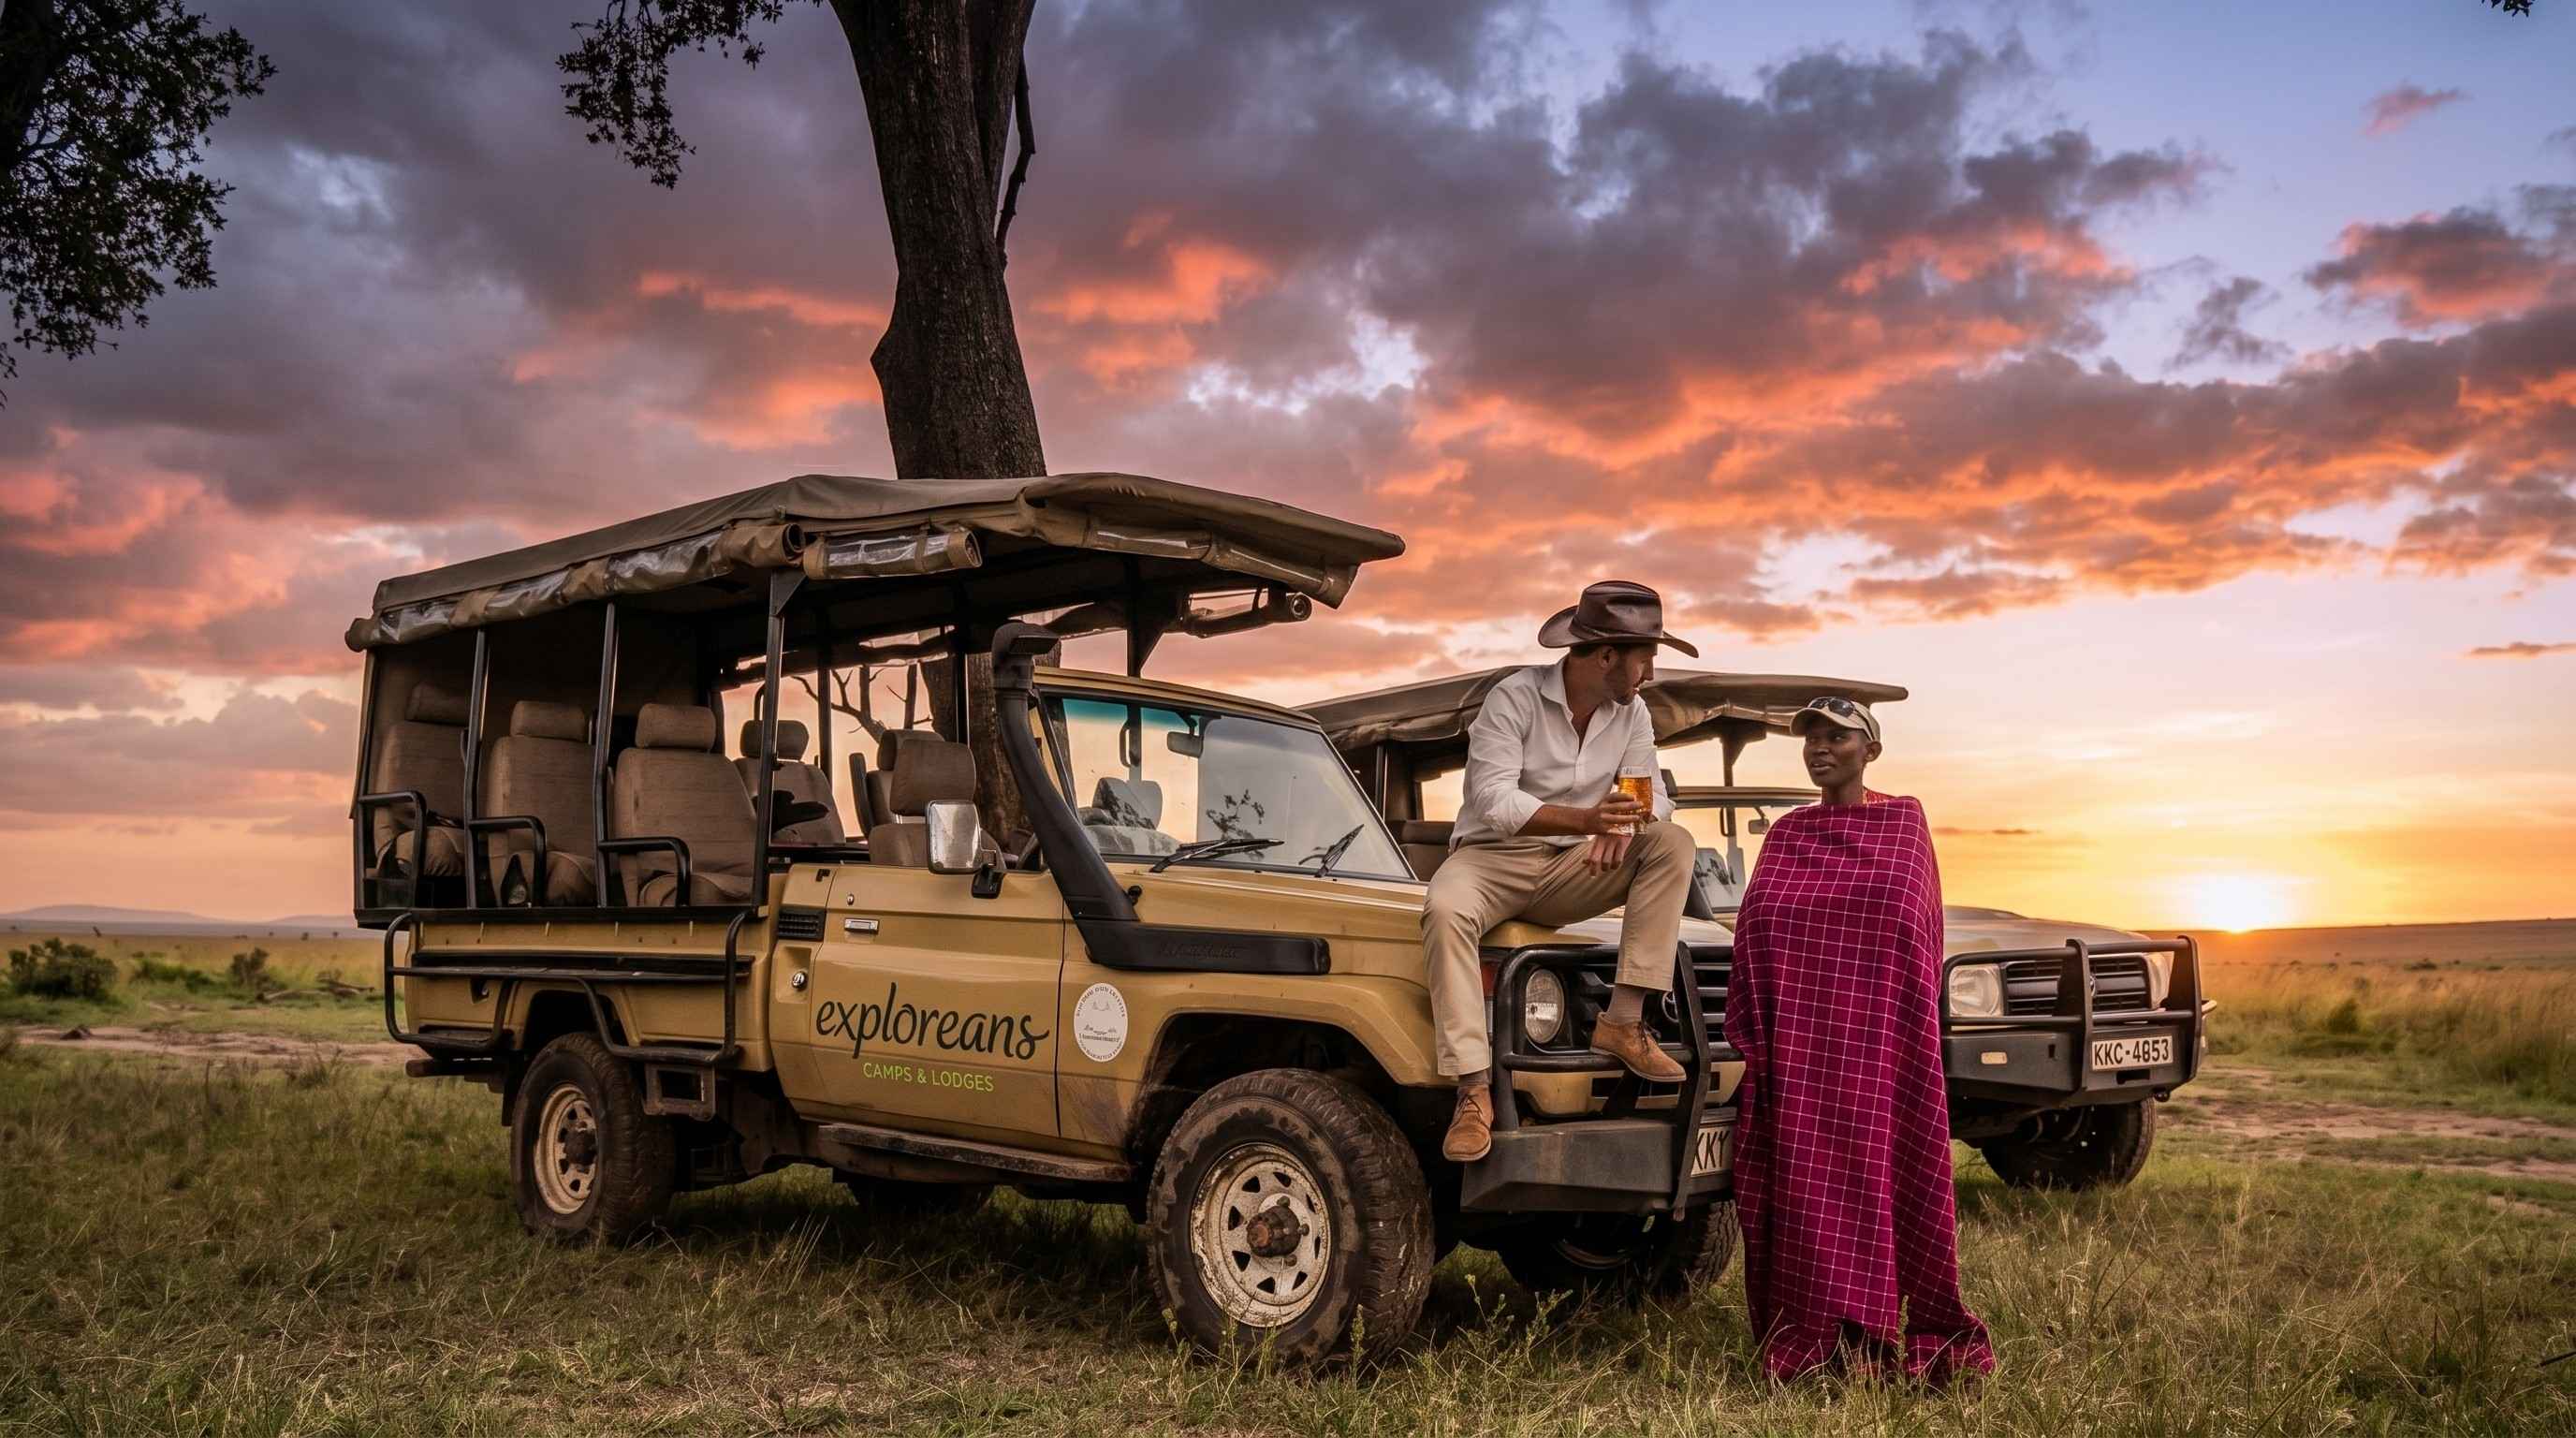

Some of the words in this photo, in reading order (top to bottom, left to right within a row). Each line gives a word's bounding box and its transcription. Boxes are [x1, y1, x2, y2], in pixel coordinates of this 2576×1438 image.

[816, 981, 1050, 1060] exploreans
[862, 1062, 914, 1083] CAMPS
[917, 1070, 928, 1084] &
[932, 1070, 994, 1092] LODGES
